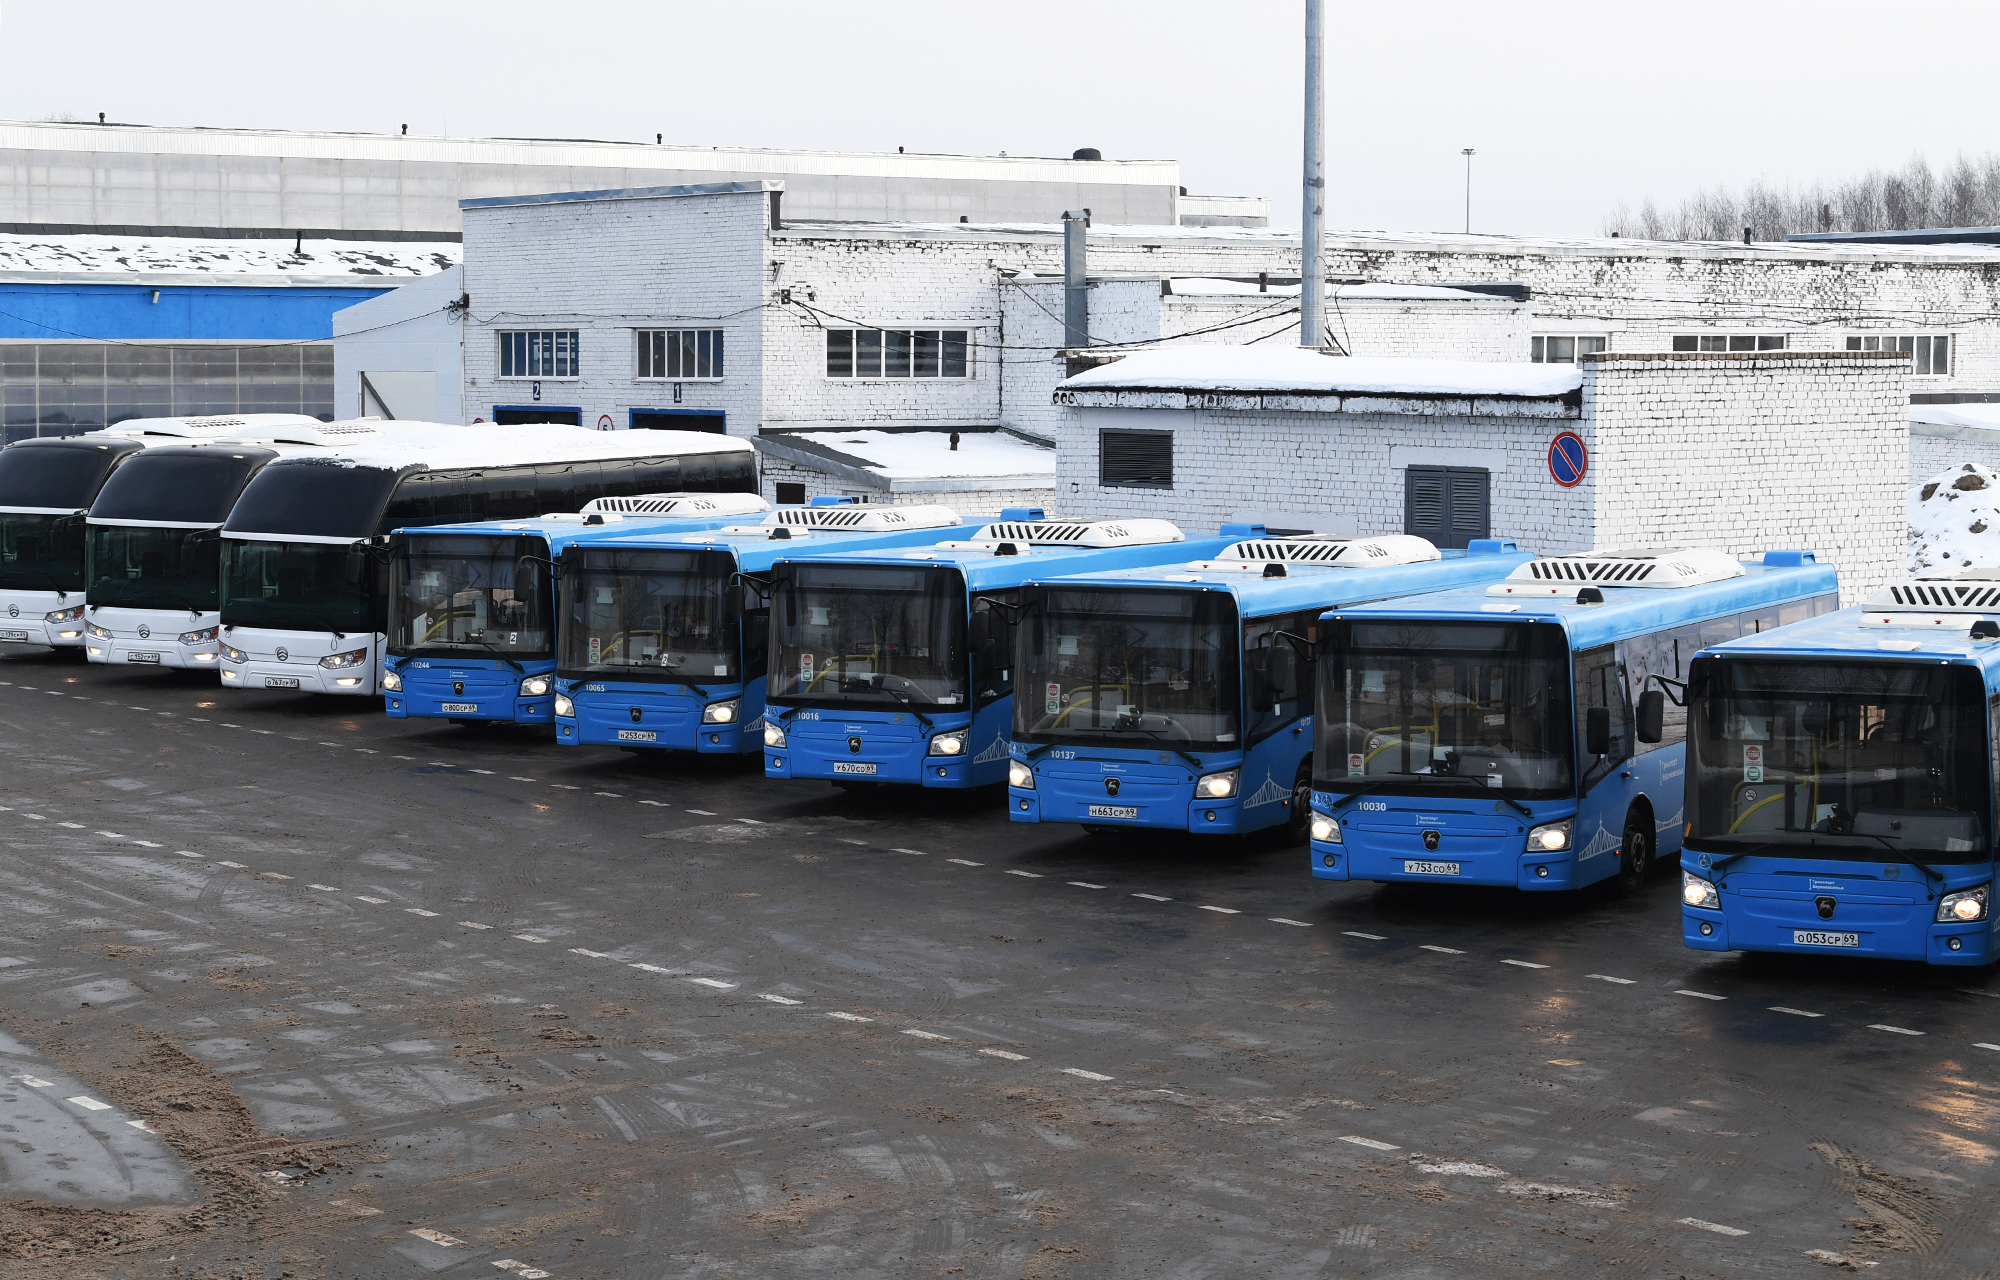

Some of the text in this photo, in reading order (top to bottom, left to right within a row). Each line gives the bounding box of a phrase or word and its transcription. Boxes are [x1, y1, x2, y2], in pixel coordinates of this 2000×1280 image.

[533, 382, 540, 399] 2
[674, 384, 682, 401] 1
[510, 633, 516, 643] 2
[410, 661, 430, 669] 10244
[585, 684, 605, 692] 10065
[797, 712, 819, 721] 10016
[620, 731, 646, 740] Н253СР
[1050, 750, 1075, 760] 10137
[836, 763, 865, 773] У670СО
[1091, 806, 1135, 817] Н663СР 69
[1358, 802, 1387, 812] 10030
[1408, 862, 1457, 874] У753СО 69
[1797, 932, 1855, 945] О053СР 69
